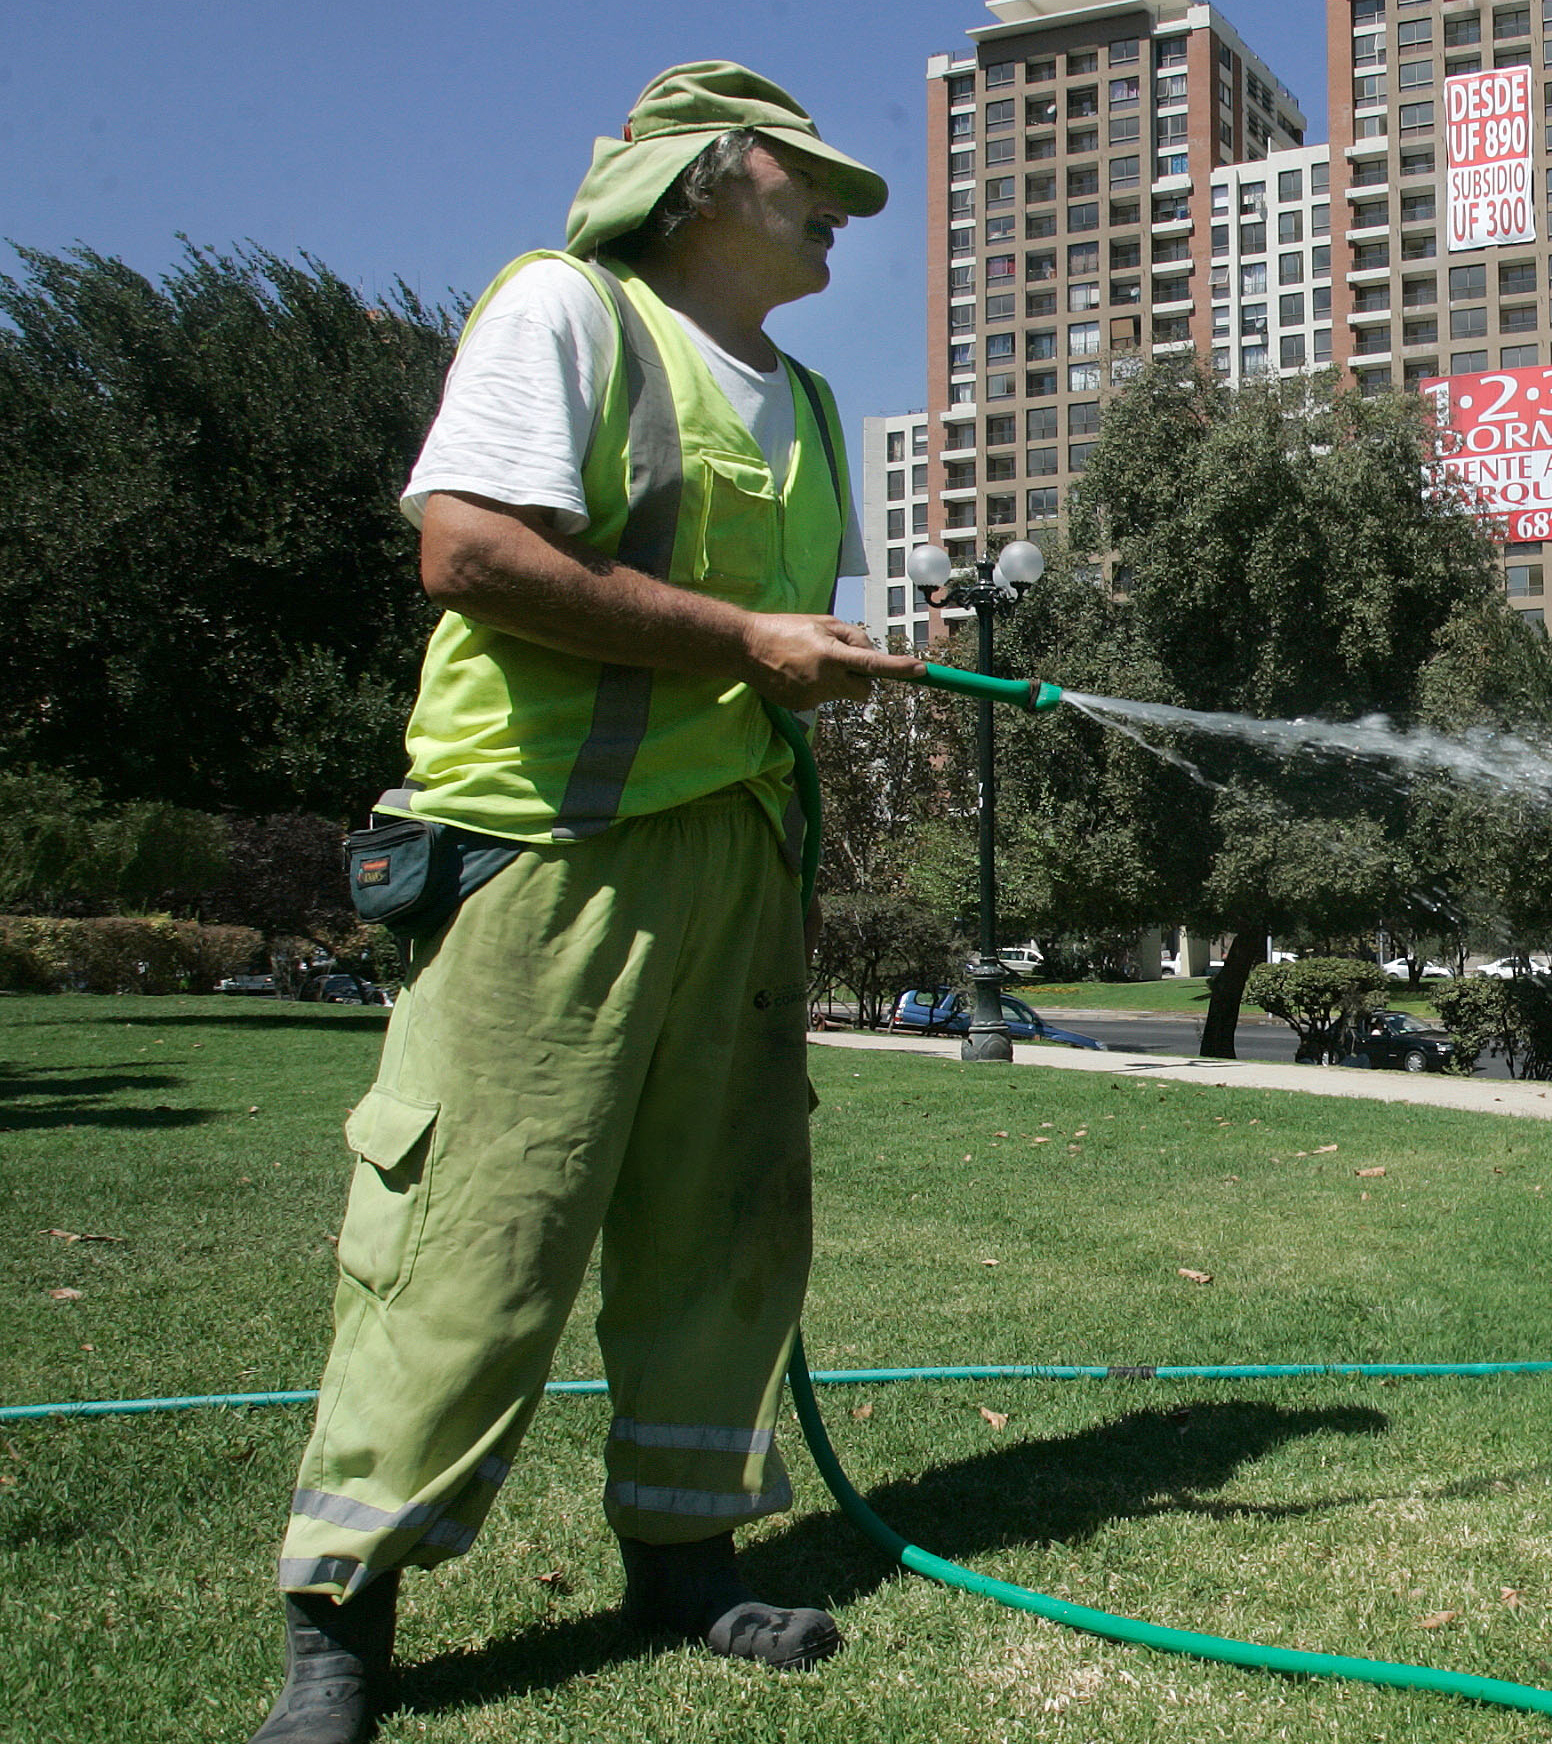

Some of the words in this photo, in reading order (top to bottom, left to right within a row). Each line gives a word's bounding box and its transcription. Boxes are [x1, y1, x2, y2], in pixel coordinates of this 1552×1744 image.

[1451, 74, 1525, 122] DESDE
[1451, 122, 1480, 163] UF
[1485, 116, 1526, 159] 890
[1452, 162, 1526, 202] SUBSIDIO
[1453, 202, 1480, 242] UF
[1486, 196, 1527, 238] 300
